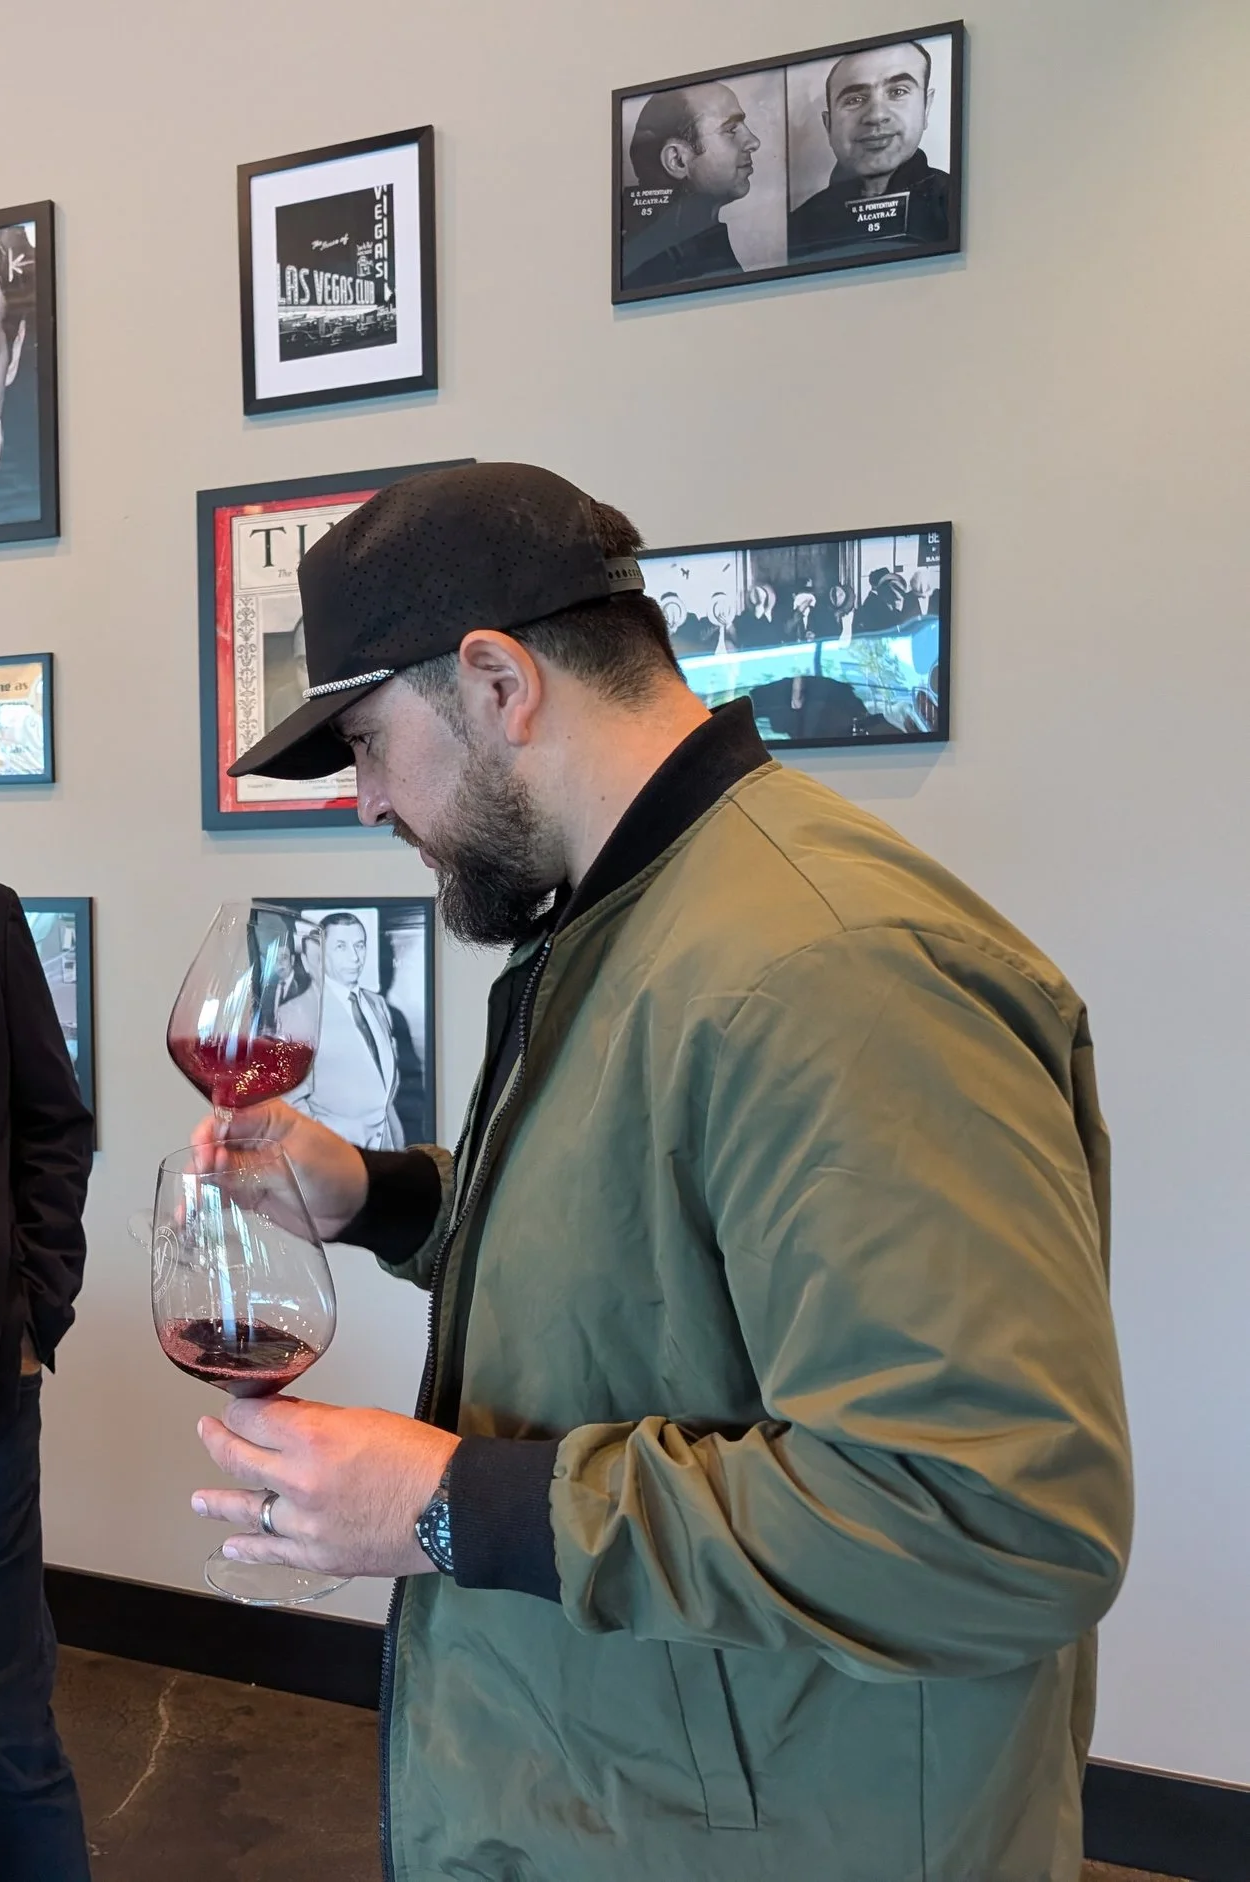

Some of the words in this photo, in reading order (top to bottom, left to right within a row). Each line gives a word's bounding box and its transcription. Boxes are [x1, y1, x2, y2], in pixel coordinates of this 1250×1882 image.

[641, 207, 653, 216] 85
[373, 185, 384, 278] VEGAS
[867, 222, 880, 232] 85
[277, 262, 310, 305] LAS
[313, 269, 354, 305] VEGAS
[355, 278, 375, 305] CLUB
[14, 681, 29, 692] as
